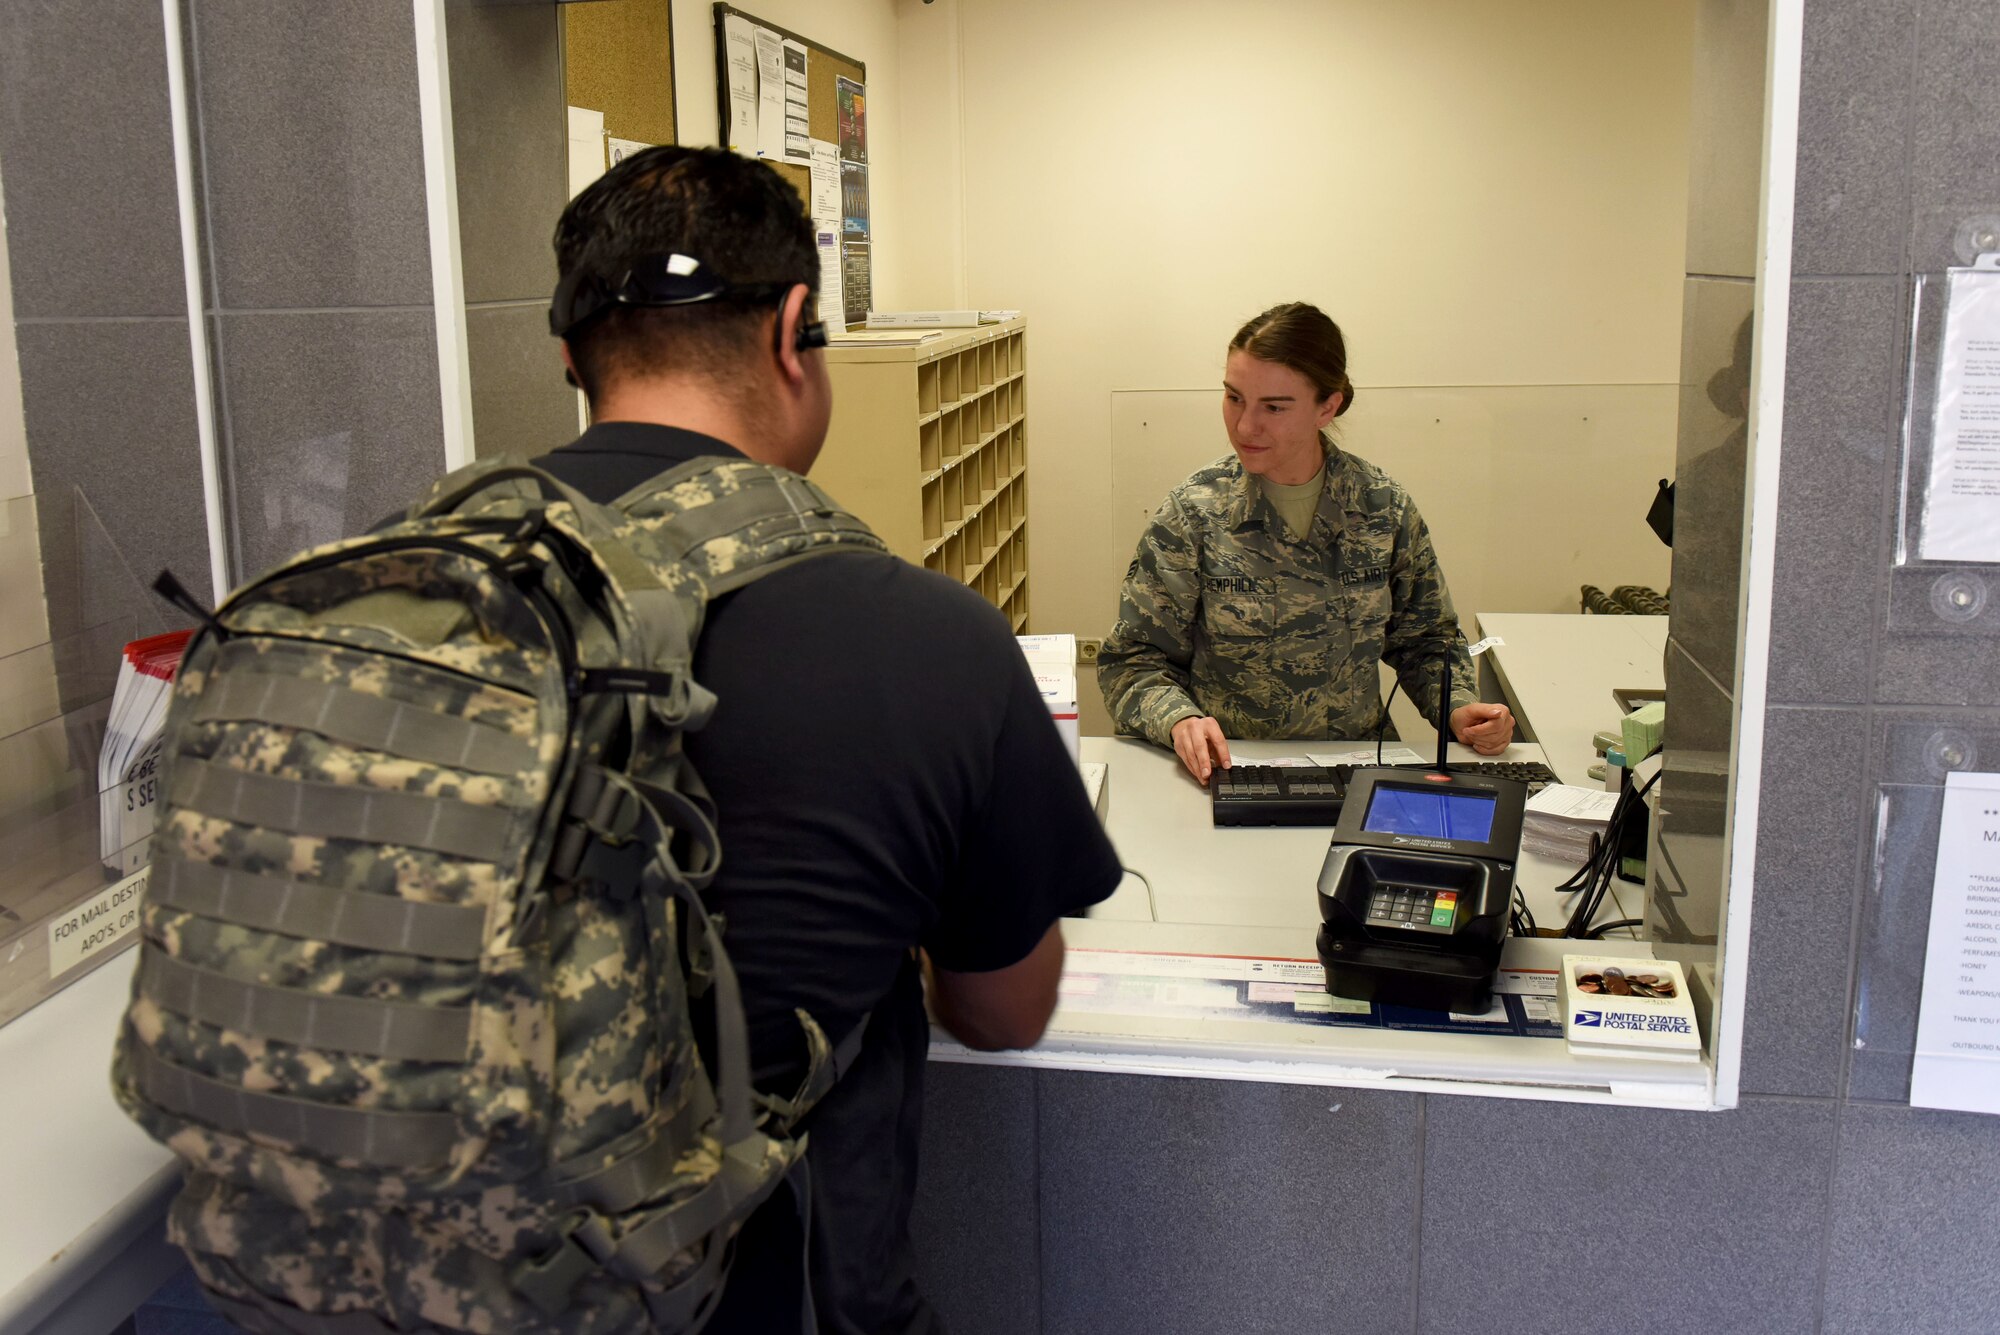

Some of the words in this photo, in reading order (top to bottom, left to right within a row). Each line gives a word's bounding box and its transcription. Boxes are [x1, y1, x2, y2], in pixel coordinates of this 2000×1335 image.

[1983, 830, 2000, 842] M
[55, 918, 79, 943] FOR
[81, 900, 111, 926] MAIL
[81, 922, 117, 954] APO'S,
[119, 910, 135, 929] OR
[1605, 1011, 1647, 1023] UNITED
[1649, 1014, 1688, 1025] STATES
[1953, 1015, 1978, 1023] THANK
[1979, 1017, 1995, 1025] YOU
[1604, 1020, 1645, 1031] POSTAL
[1647, 1023, 1692, 1034] SERVICE
